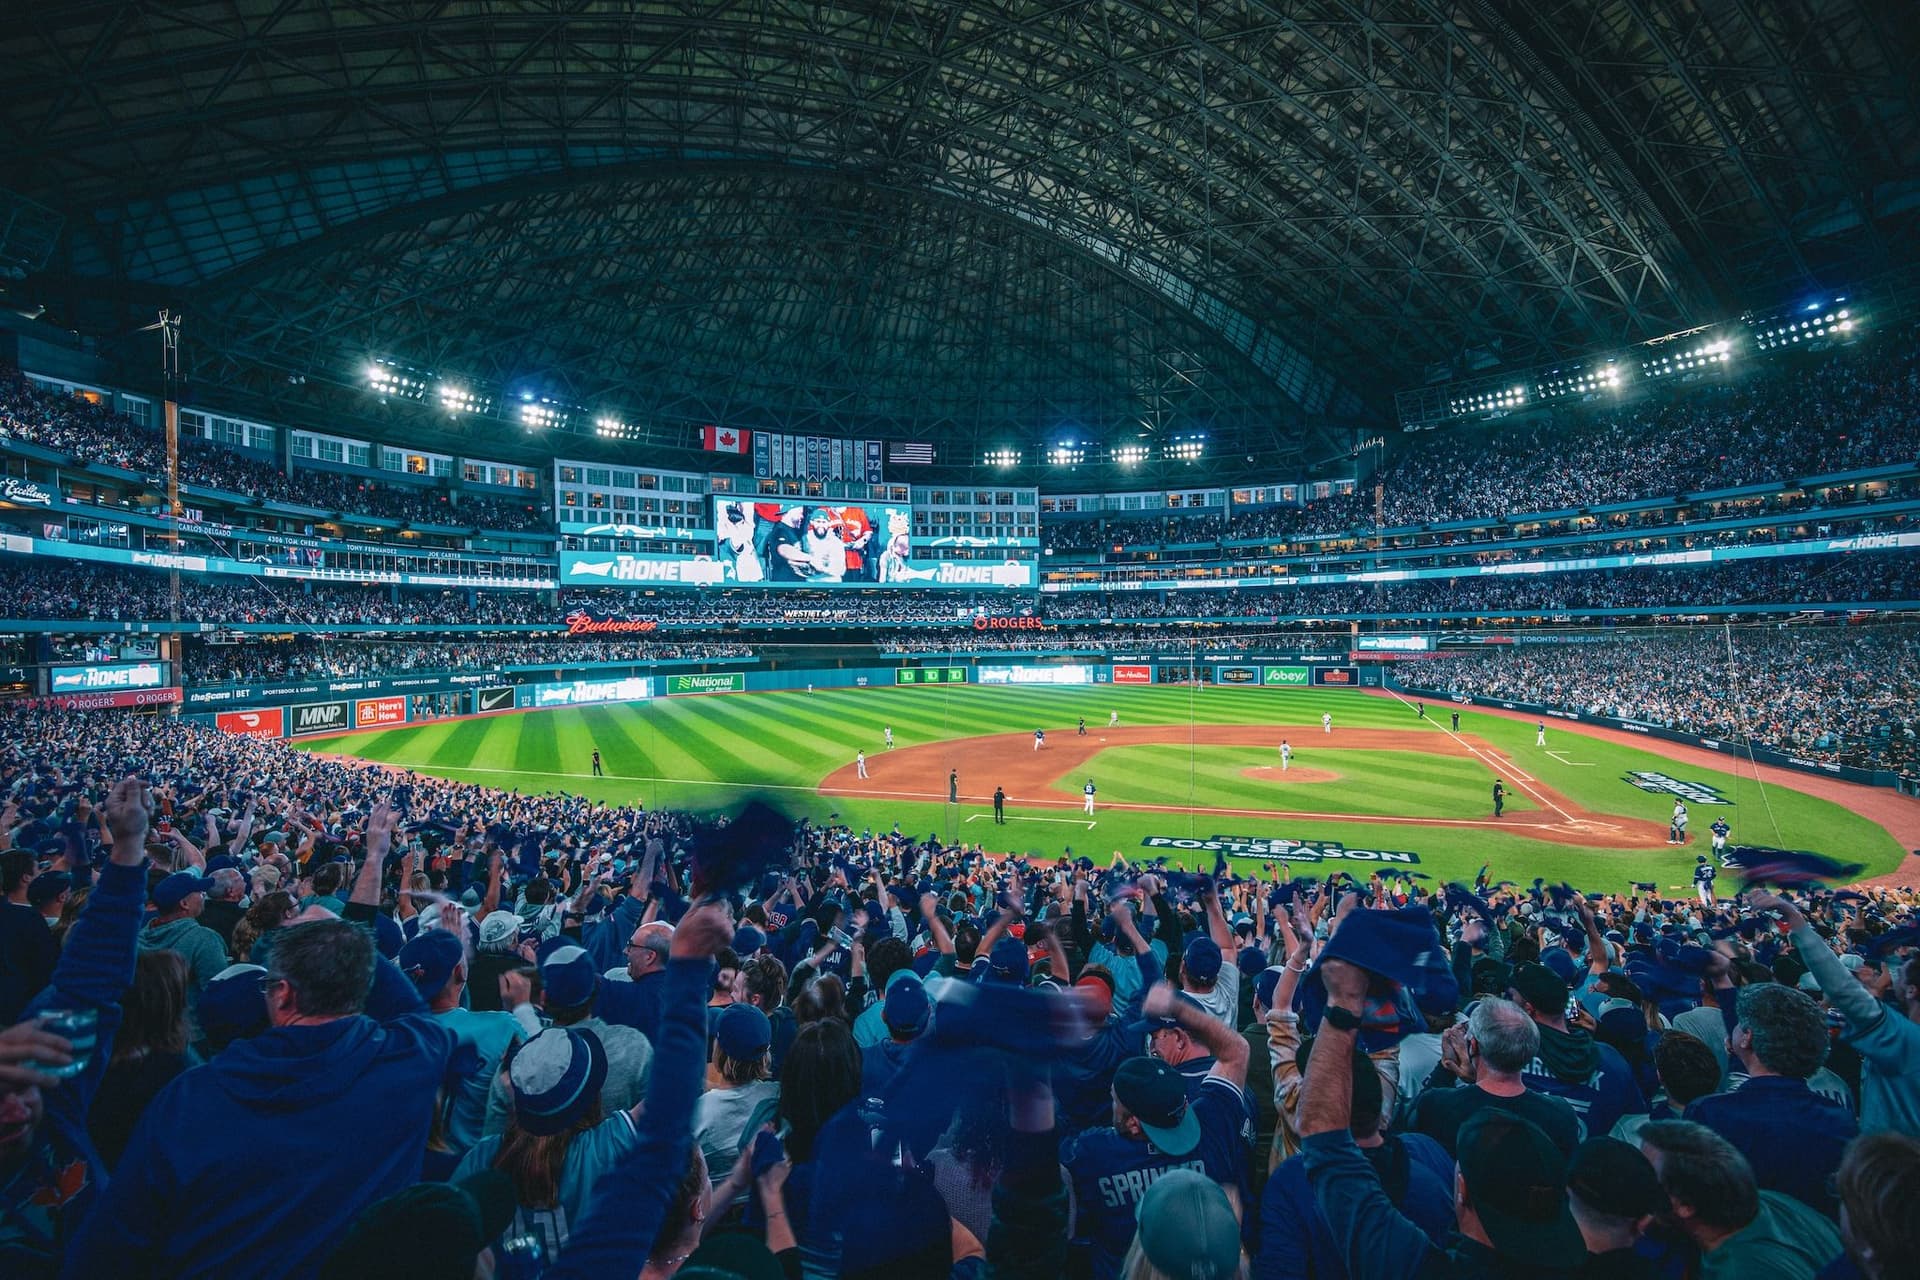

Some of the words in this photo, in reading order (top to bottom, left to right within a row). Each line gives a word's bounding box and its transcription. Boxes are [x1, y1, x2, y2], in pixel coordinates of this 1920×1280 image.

[867, 460, 881, 471] 32
[178, 523, 202, 534] CARLOS
[204, 527, 232, 537] DELGADO
[267, 535, 283, 544] 4306
[285, 537, 298, 545] TOM
[300, 539, 318, 547] CHEEK
[1857, 534, 1898, 550] HOME
[346, 544, 363, 552] TONY
[364, 546, 397, 555] FERNANDEZ
[617, 556, 680, 581] HOME
[939, 563, 993, 584] HOME
[566, 613, 657, 634] Budweiser
[991, 617, 1042, 629] ROGERS
[1522, 635, 1558, 643] TORONTO
[136, 641, 156, 652] SN
[85, 667, 129, 687] HOME
[903, 672, 914, 680] TD
[928, 672, 938, 680] TD
[951, 671, 962, 680] TD
[1115, 670, 1126, 678] Tim
[1127, 670, 1149, 678] Hortons
[1267, 670, 1306, 683] Sobeys
[691, 676, 734, 687] National
[236, 689, 250, 698] BET
[262, 688, 295, 696] SPORTSBOOK
[575, 682, 617, 701] HOME
[79, 698, 115, 709] ROGERS
[146, 692, 177, 704] ROGERS
[378, 702, 402, 711] Here's
[300, 706, 341, 726] MNP
[378, 712, 398, 721] How.
[1149, 838, 1411, 862] POSTSEASON
